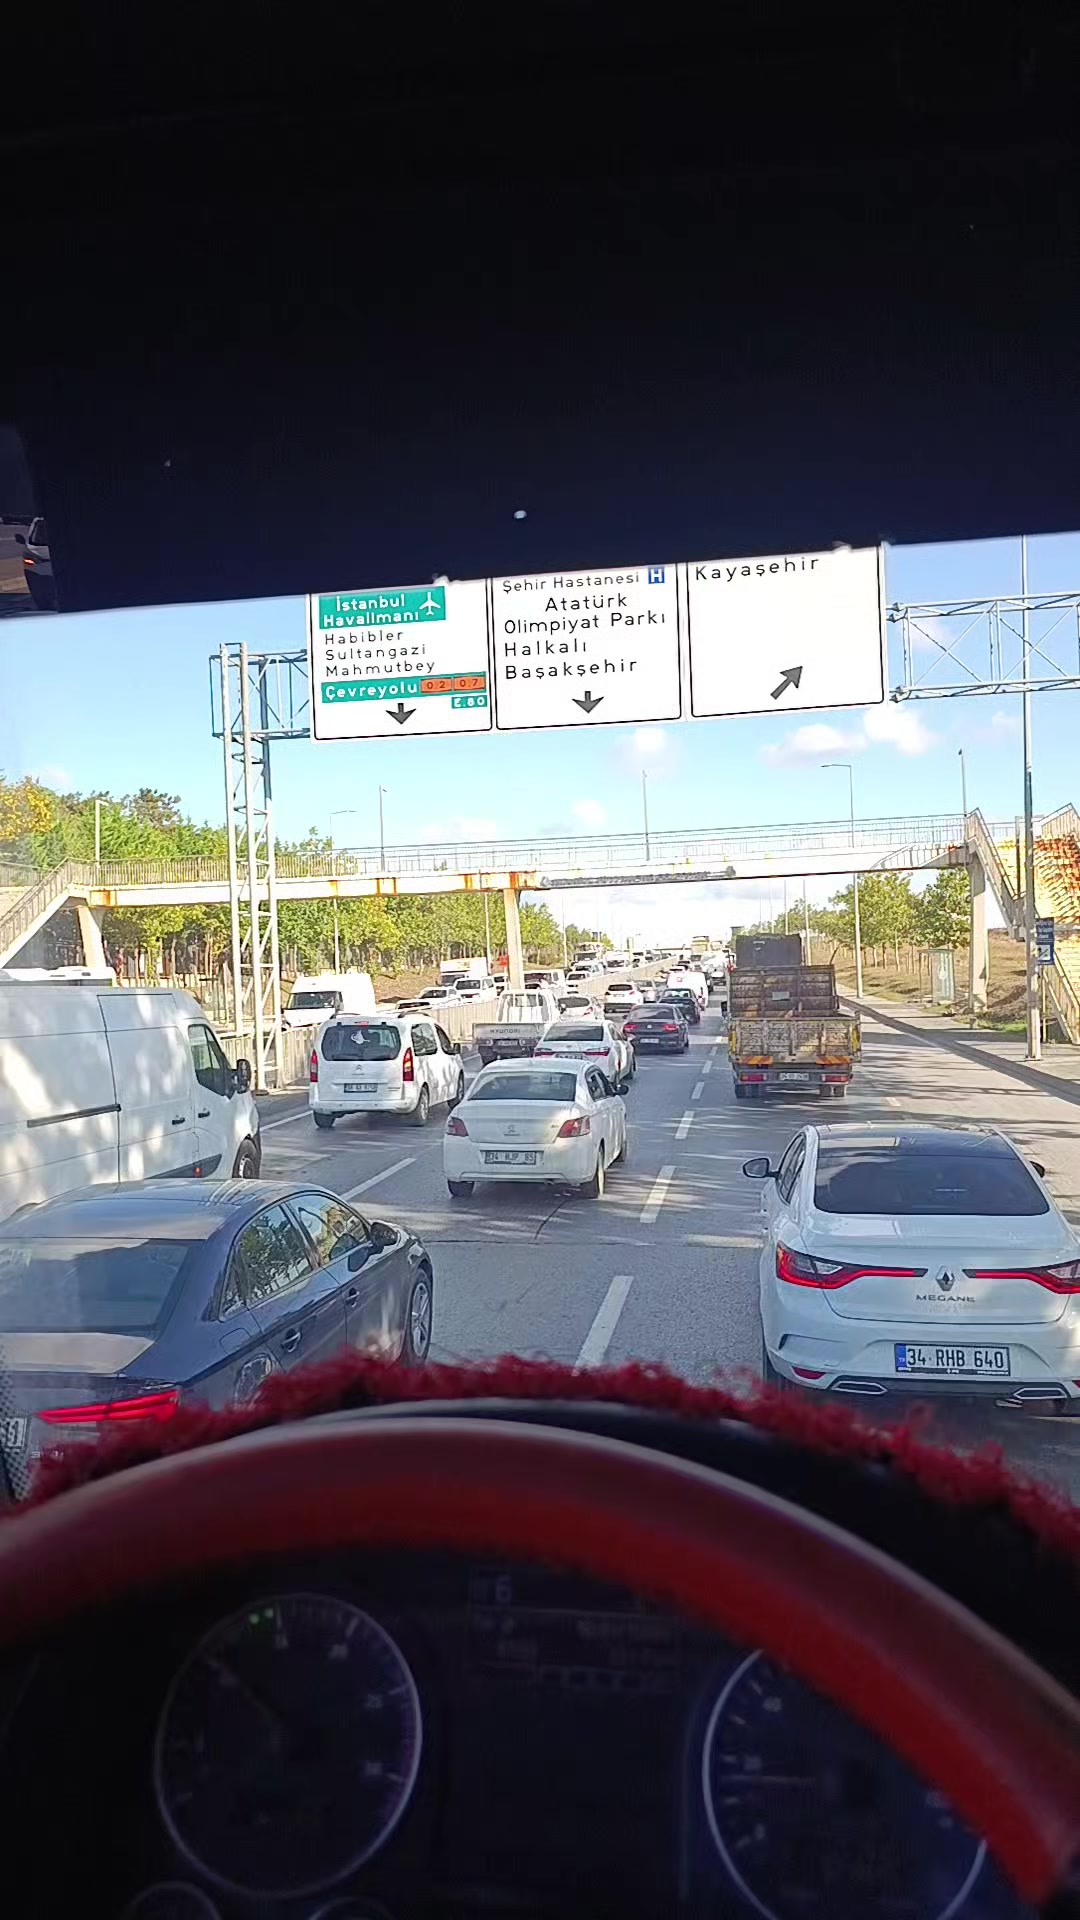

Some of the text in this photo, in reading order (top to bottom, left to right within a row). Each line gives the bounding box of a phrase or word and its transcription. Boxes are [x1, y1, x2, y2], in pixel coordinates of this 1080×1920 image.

[695, 557, 820, 583] Kayaşehir
[502, 579, 547, 594] Şehir
[553, 572, 640, 589] Hastanesi
[336, 594, 405, 612] İstanbul
[545, 593, 628, 612] Atatürk
[504, 610, 666, 636] Olimpiyat Parkı
[325, 630, 403, 645] Habibler
[325, 644, 426, 661] Sultangazi
[504, 638, 587, 657] Halkalı
[326, 661, 435, 677] Mahmutbey
[505, 659, 637, 680] Başakşehir
[325, 681, 418, 700] Çevreyolu
[916, 1294, 976, 1303] MEGANE
[907, 1348, 1004, 1368] 34 RHB 640
